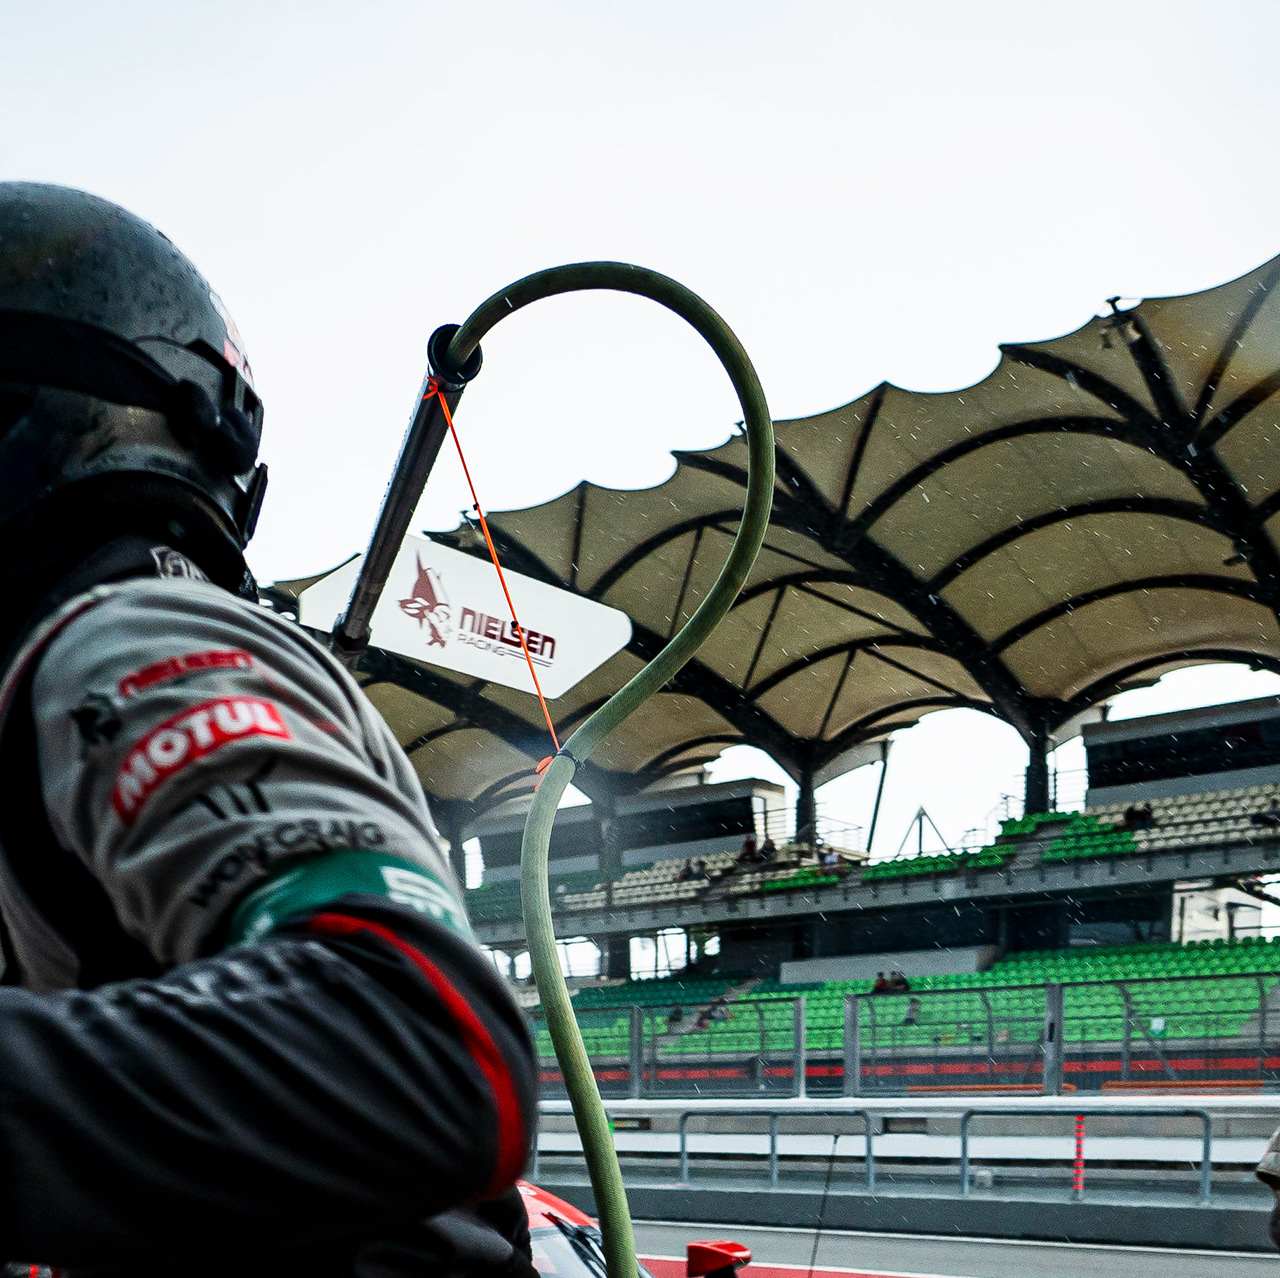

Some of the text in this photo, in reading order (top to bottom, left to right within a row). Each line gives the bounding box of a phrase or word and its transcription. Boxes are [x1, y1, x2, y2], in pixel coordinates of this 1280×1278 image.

[457, 632, 508, 657] RACING
[458, 605, 557, 660] NIELSEN
[118, 701, 282, 808] MOTUL
